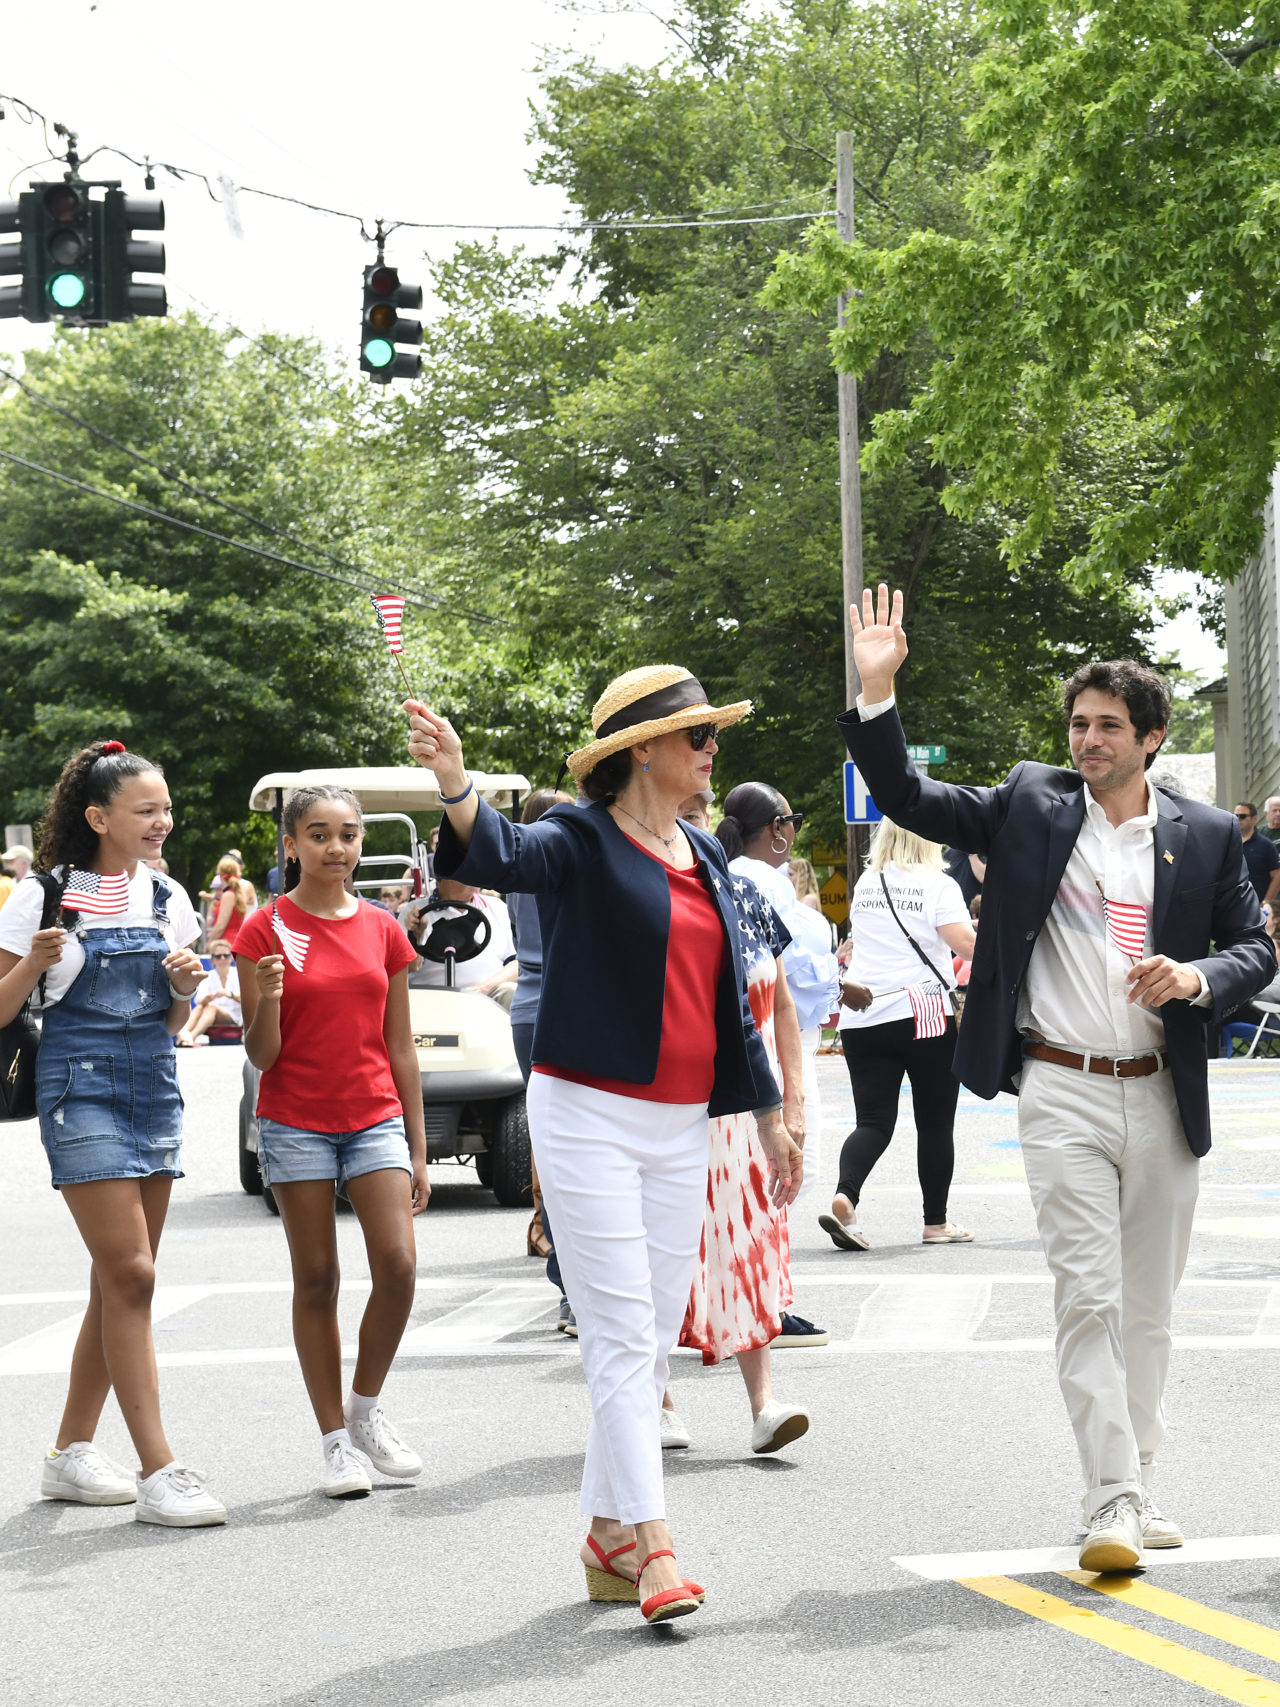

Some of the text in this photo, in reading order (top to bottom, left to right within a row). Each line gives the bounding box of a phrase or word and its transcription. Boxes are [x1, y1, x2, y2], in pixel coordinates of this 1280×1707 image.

[821, 893, 847, 905] BUM
[897, 900, 923, 912] TEAM
[413, 1035, 436, 1047] Car
